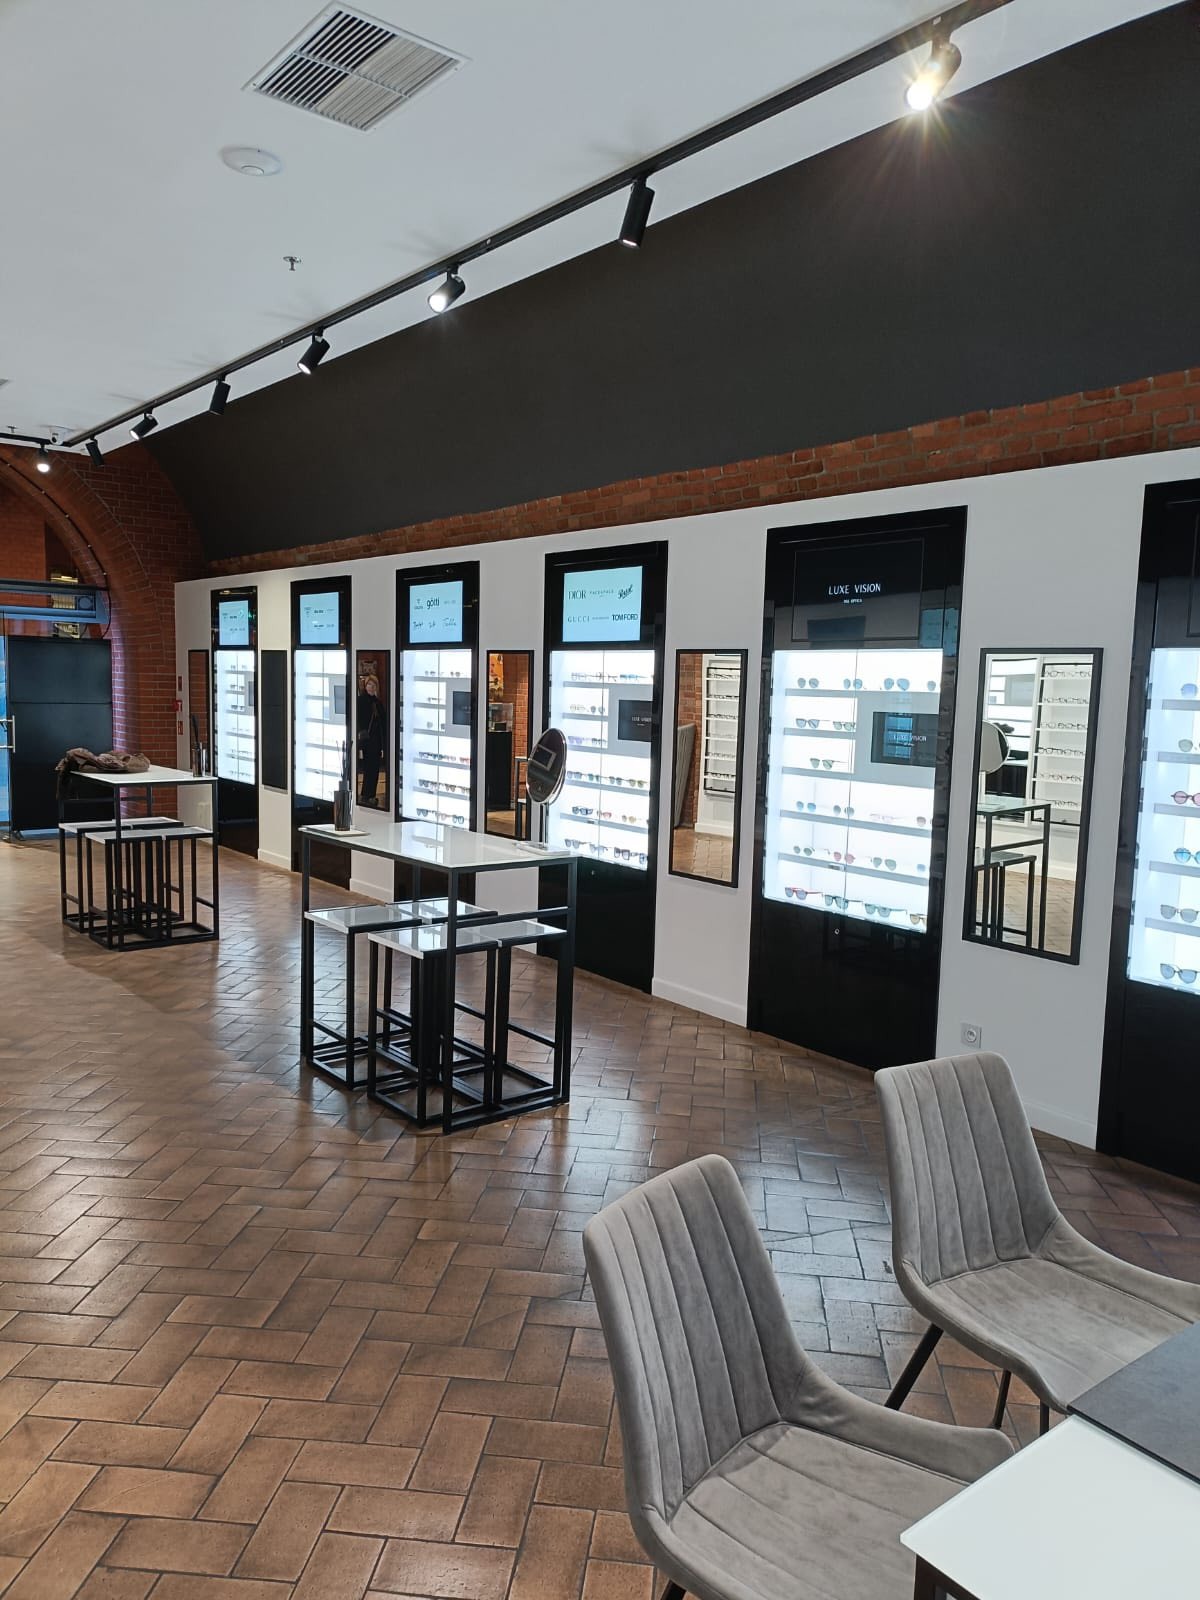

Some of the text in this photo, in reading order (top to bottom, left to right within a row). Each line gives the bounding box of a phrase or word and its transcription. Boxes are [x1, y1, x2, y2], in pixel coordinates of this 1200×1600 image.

[828, 583, 881, 596] LUXE VISION
[568, 590, 587, 600] DIOR
[567, 615, 590, 623] GUCCI
